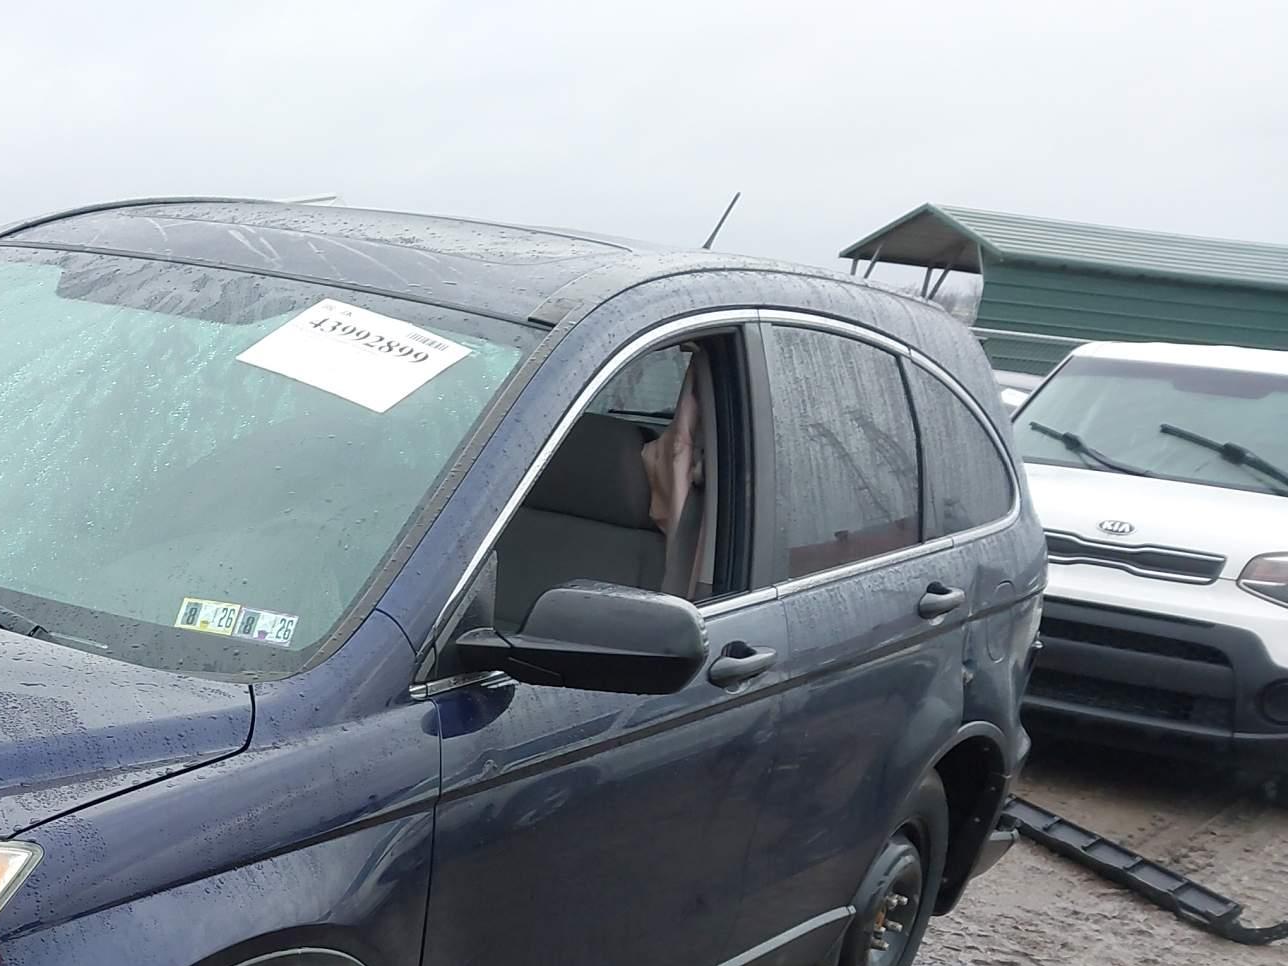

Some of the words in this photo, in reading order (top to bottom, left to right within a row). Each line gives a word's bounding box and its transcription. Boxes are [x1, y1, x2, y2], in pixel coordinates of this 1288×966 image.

[309, 317, 429, 363] 43992899
[1102, 520, 1131, 533] KIA
[217, 607, 235, 628] 26
[275, 618, 294, 640] 26
